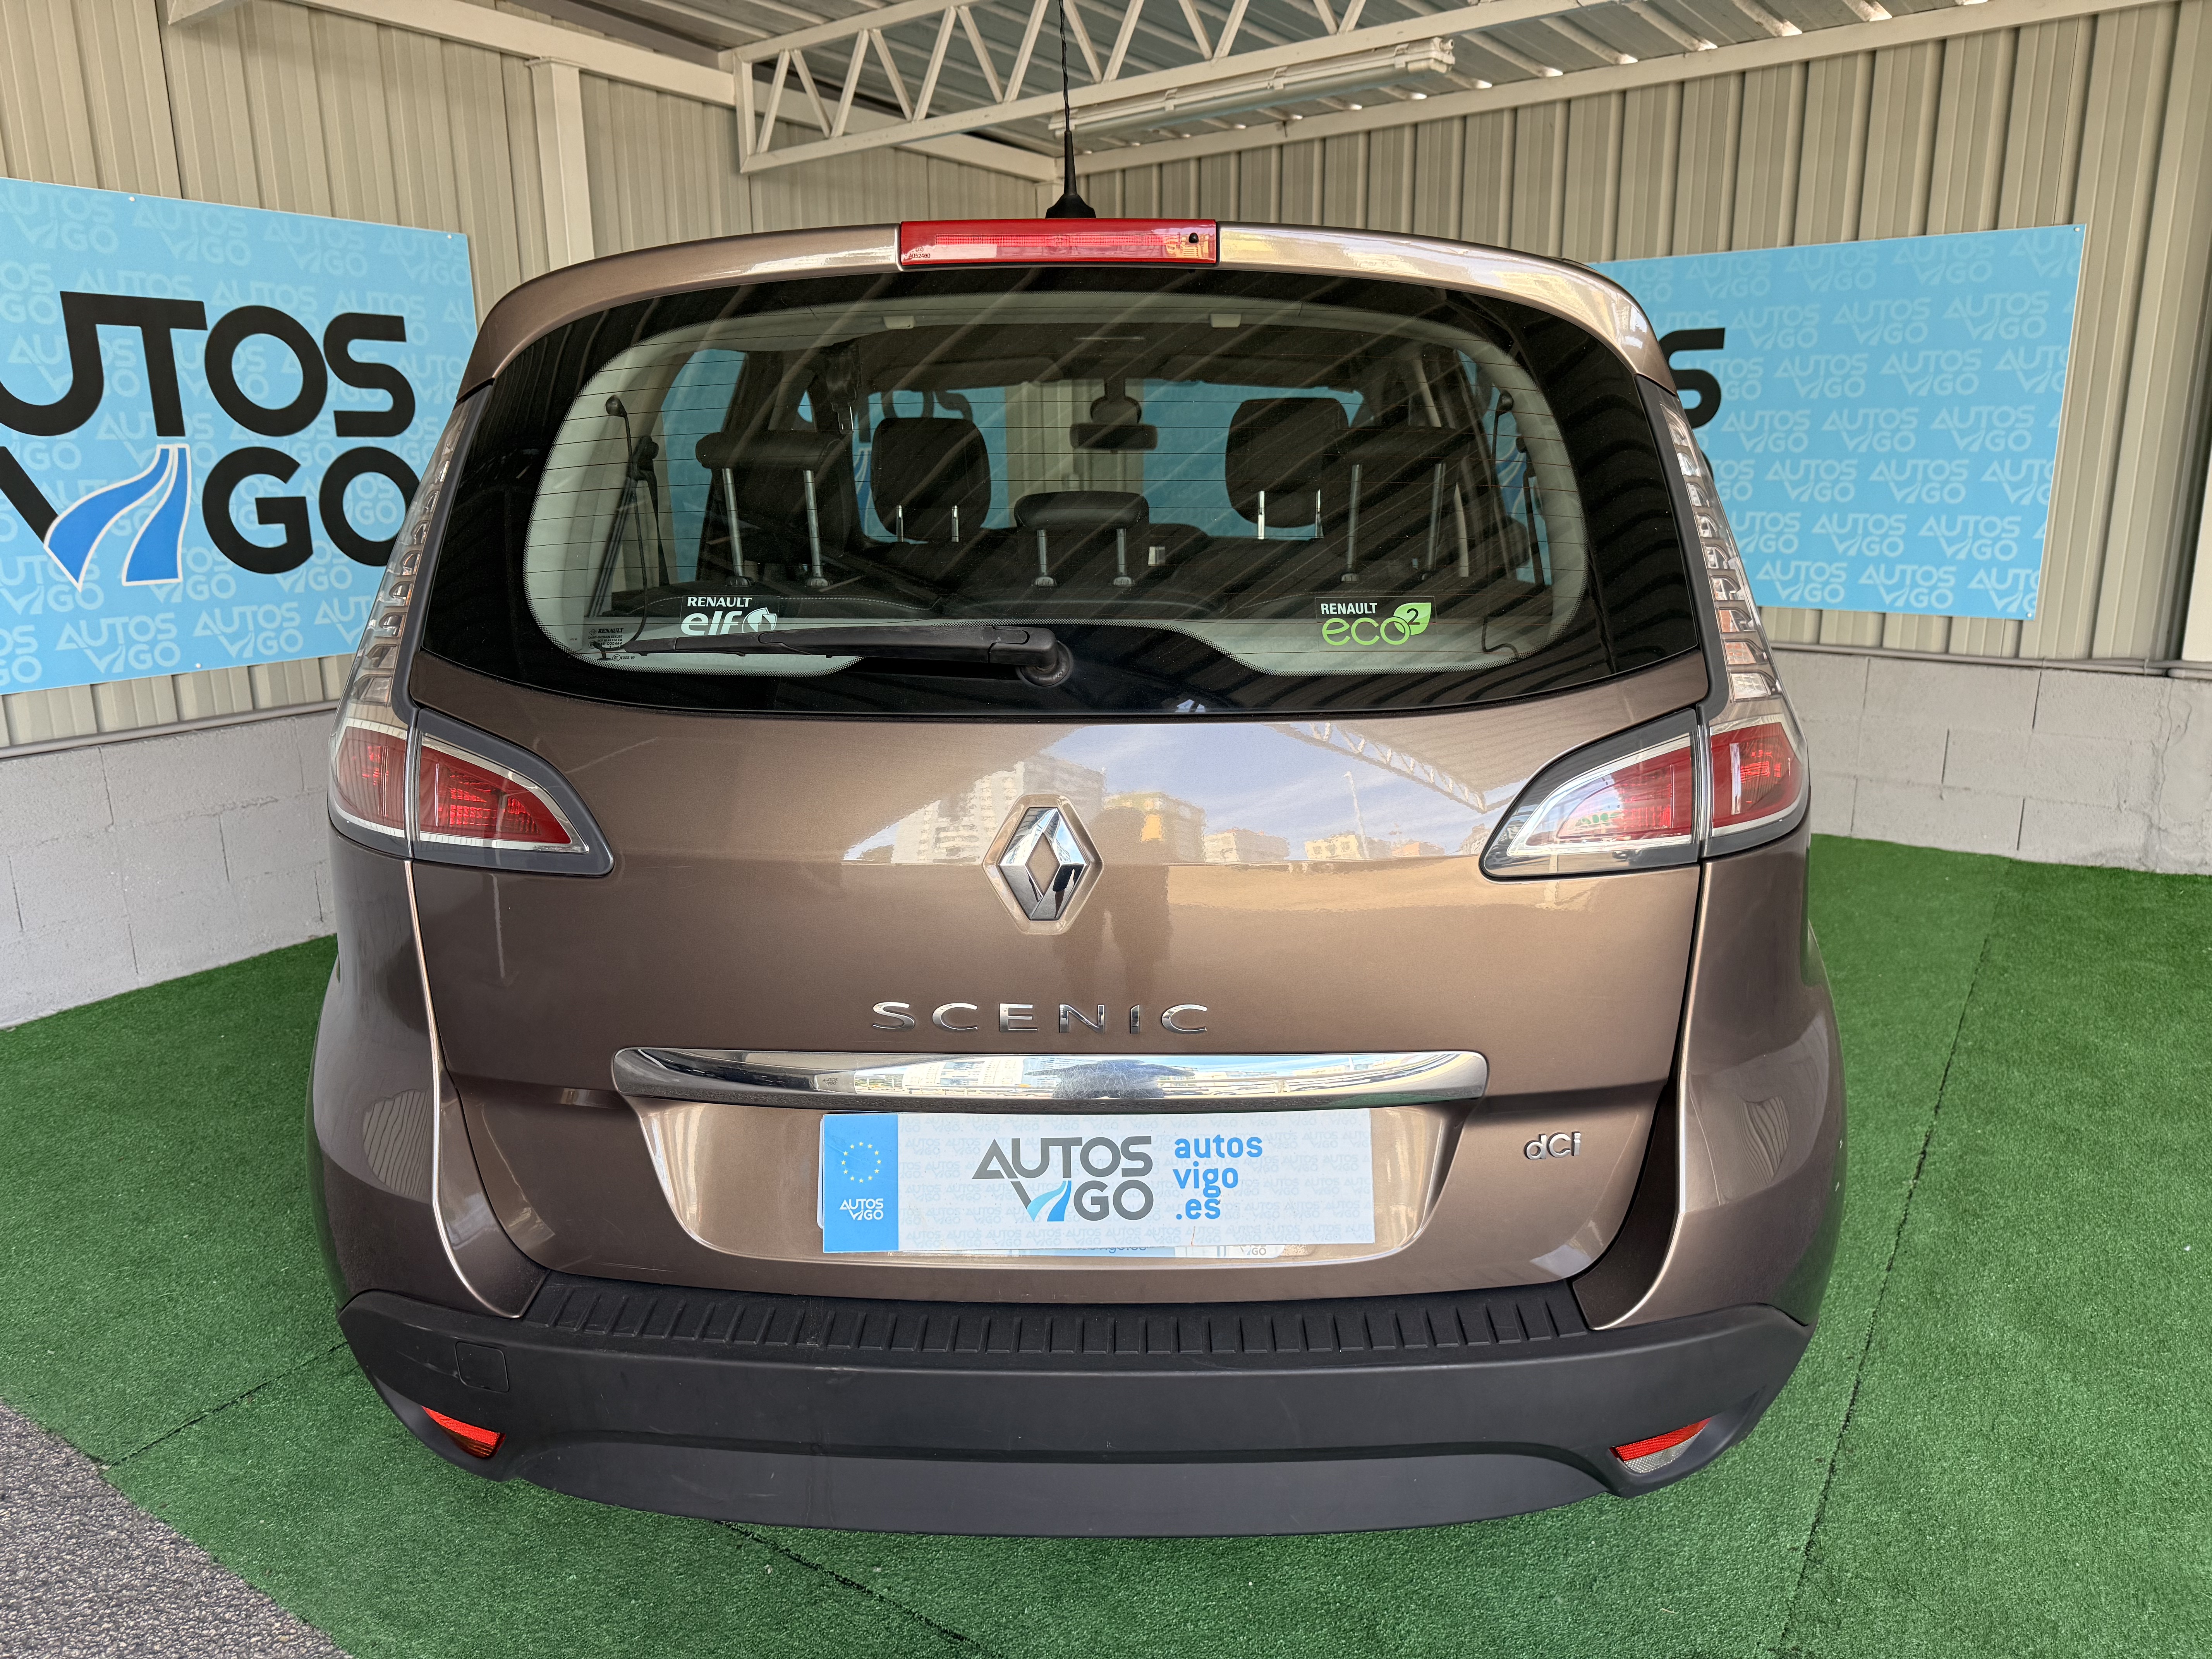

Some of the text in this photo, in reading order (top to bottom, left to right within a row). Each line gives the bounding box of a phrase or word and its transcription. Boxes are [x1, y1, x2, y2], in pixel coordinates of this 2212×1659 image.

[132, 201, 248, 238] AUTOS
[263, 216, 365, 251] AUTOS
[379, 230, 467, 261] AUTOS
[1785, 243, 1878, 272] AUTOS
[1891, 235, 1996, 265] AUTOS
[1685, 254, 1772, 280] AUTOS
[1831, 297, 1931, 324] AUTOS
[1942, 290, 2051, 319] AUTOS
[1731, 304, 1820, 330] AUTOS
[0, 291, 416, 437] UTOS
[397, 354, 464, 380] AUTO
[1774, 353, 1869, 377] AUTOS
[1879, 349, 1982, 374] AUTOS
[1721, 410, 1810, 432] AUTOS
[1822, 408, 1919, 431] AUTOS
[1931, 405, 2035, 429] AUTOS
[1738, 431, 1808, 453] VIGO
[1841, 431, 1915, 452] VIGO
[1951, 429, 2032, 452] VIGO
[1765, 459, 1858, 481] AUTOS
[1869, 459, 1969, 481] AUTOS
[1783, 480, 1855, 503] VIGO
[1887, 481, 1966, 504] VIGO
[0, 445, 421, 591] VIGO
[1811, 512, 1908, 536] AUTOS
[1917, 514, 2022, 538] AUTOS
[1830, 535, 1904, 558] VIGO
[1937, 538, 2018, 561] VIGO
[1755, 560, 1848, 583] AUTOS
[1858, 563, 1957, 587] AUTOS
[687, 597, 752, 607] RENAULT
[1774, 583, 1845, 604] VIGO
[1877, 586, 1954, 609] VIGO
[192, 601, 301, 637] AUTOS
[1321, 603, 1377, 614] RENAULT
[55, 611, 178, 651] AUTOS
[681, 611, 742, 635] elf
[218, 628, 304, 658] VIGO
[84, 641, 181, 674] VIGO
[872, 1001, 1208, 1034] SCENIC
[972, 1135, 1152, 1179] AUTOS
[1175, 1134, 1262, 1159] autos
[1524, 1131, 1581, 1160] dCi
[1172, 1161, 1238, 1198] vigo
[839, 1198, 884, 1210] AUTOS
[1010, 1179, 1154, 1222] VIGO
[1176, 1199, 1221, 1220] .es
[849, 1209, 884, 1220] VIGO
